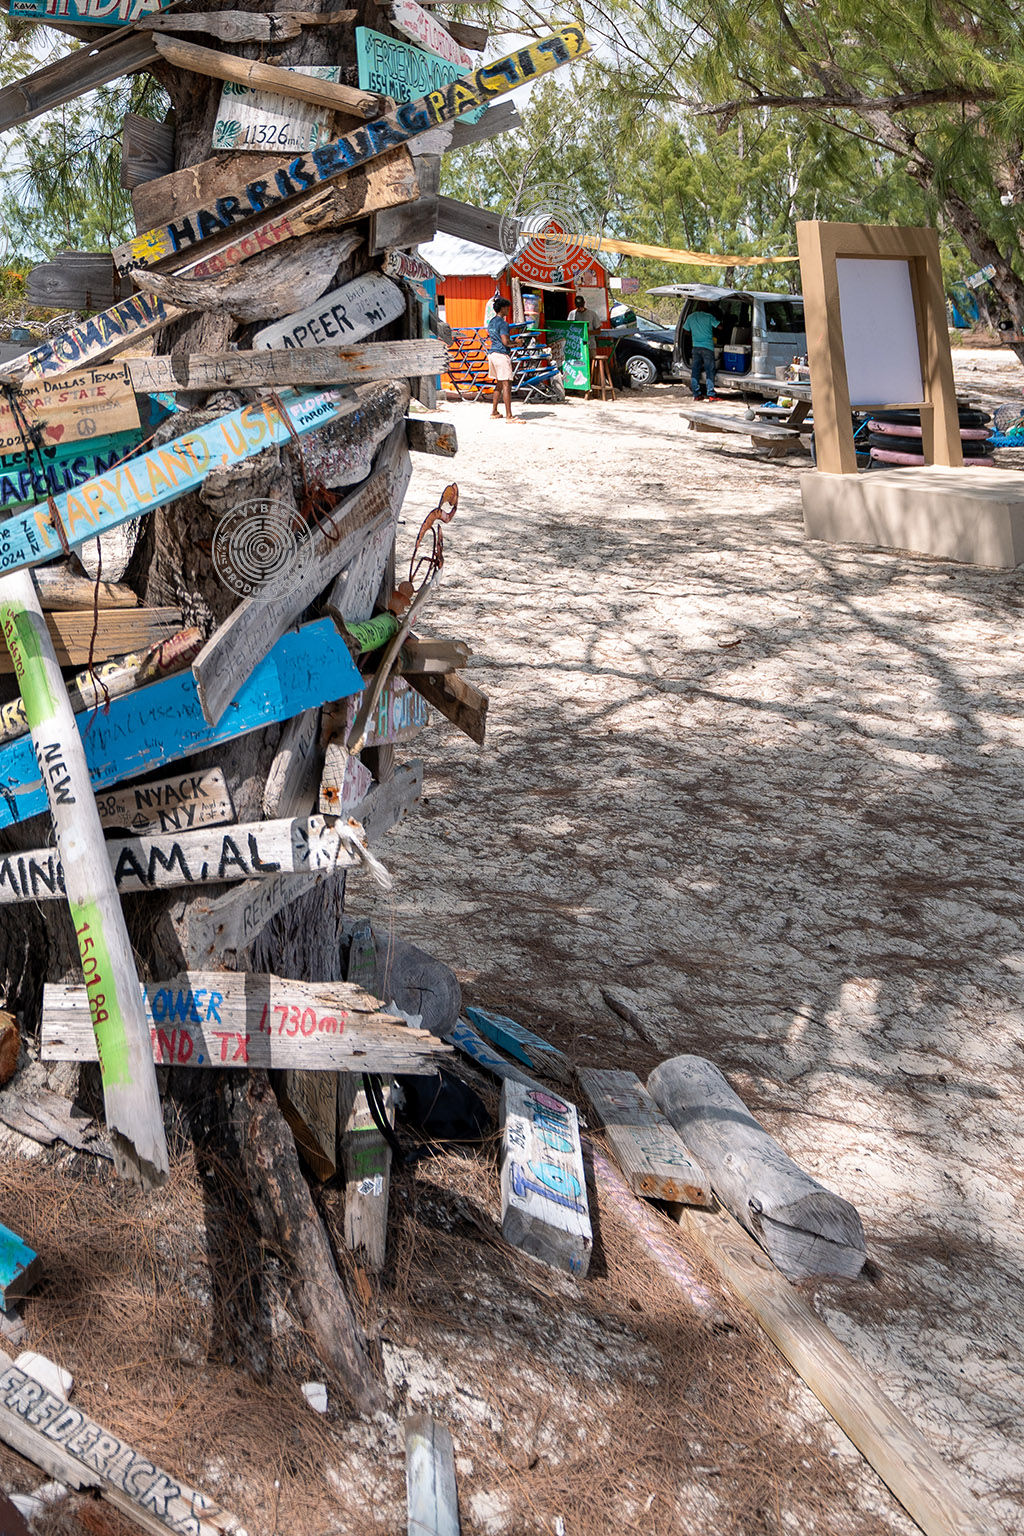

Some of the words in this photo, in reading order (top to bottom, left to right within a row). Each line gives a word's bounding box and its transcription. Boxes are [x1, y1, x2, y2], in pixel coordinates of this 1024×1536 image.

[243, 123, 289, 146] 11326
[168, 103, 432, 252] HARRISBURG
[425, 79, 480, 124] PA
[221, 400, 283, 457] USA
[42, 742, 76, 805] NEW
[134, 777, 209, 811] NYACK
[159, 804, 197, 834] NY
[219, 832, 281, 879] AL
[211, 1030, 251, 1064] TX
